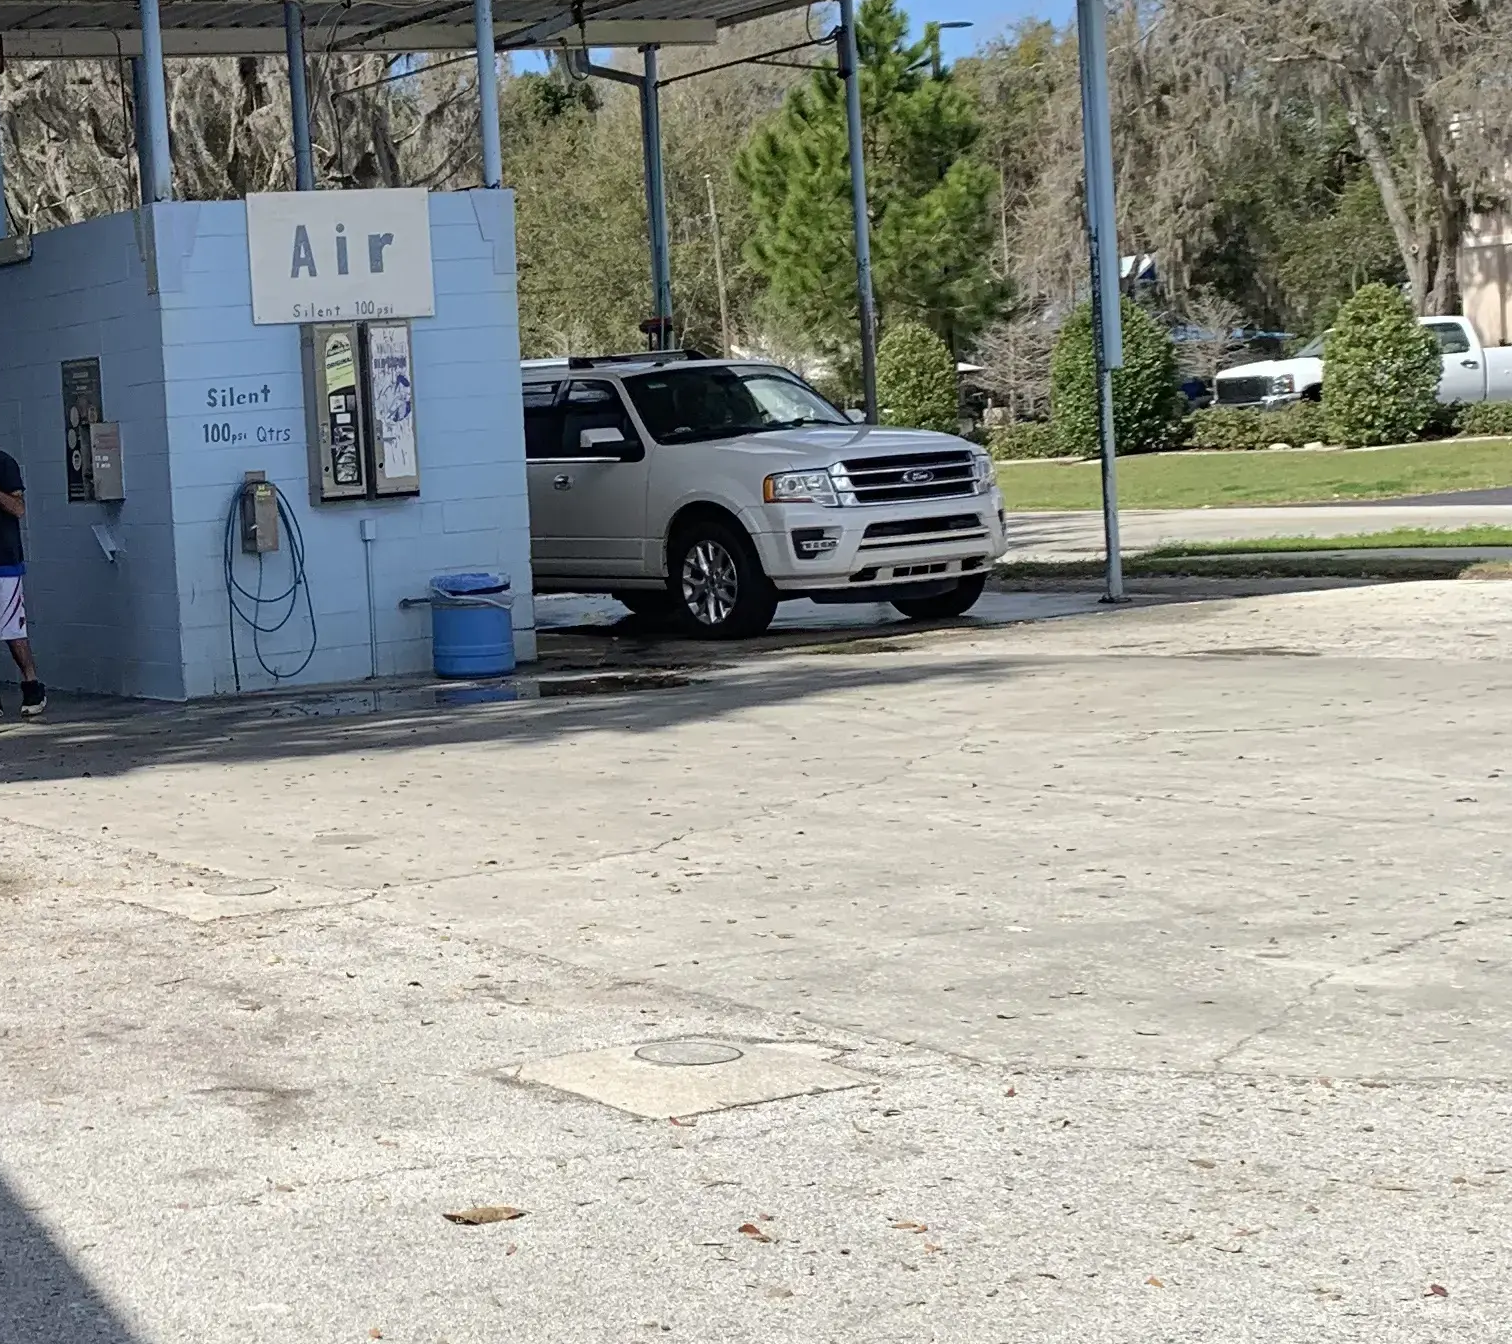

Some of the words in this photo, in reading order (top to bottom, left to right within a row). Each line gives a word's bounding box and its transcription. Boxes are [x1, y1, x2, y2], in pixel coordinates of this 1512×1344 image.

[290, 223, 394, 278] Air
[292, 302, 341, 317] Silent
[206, 384, 271, 408] Silent
[256, 425, 291, 443] Qtrs
